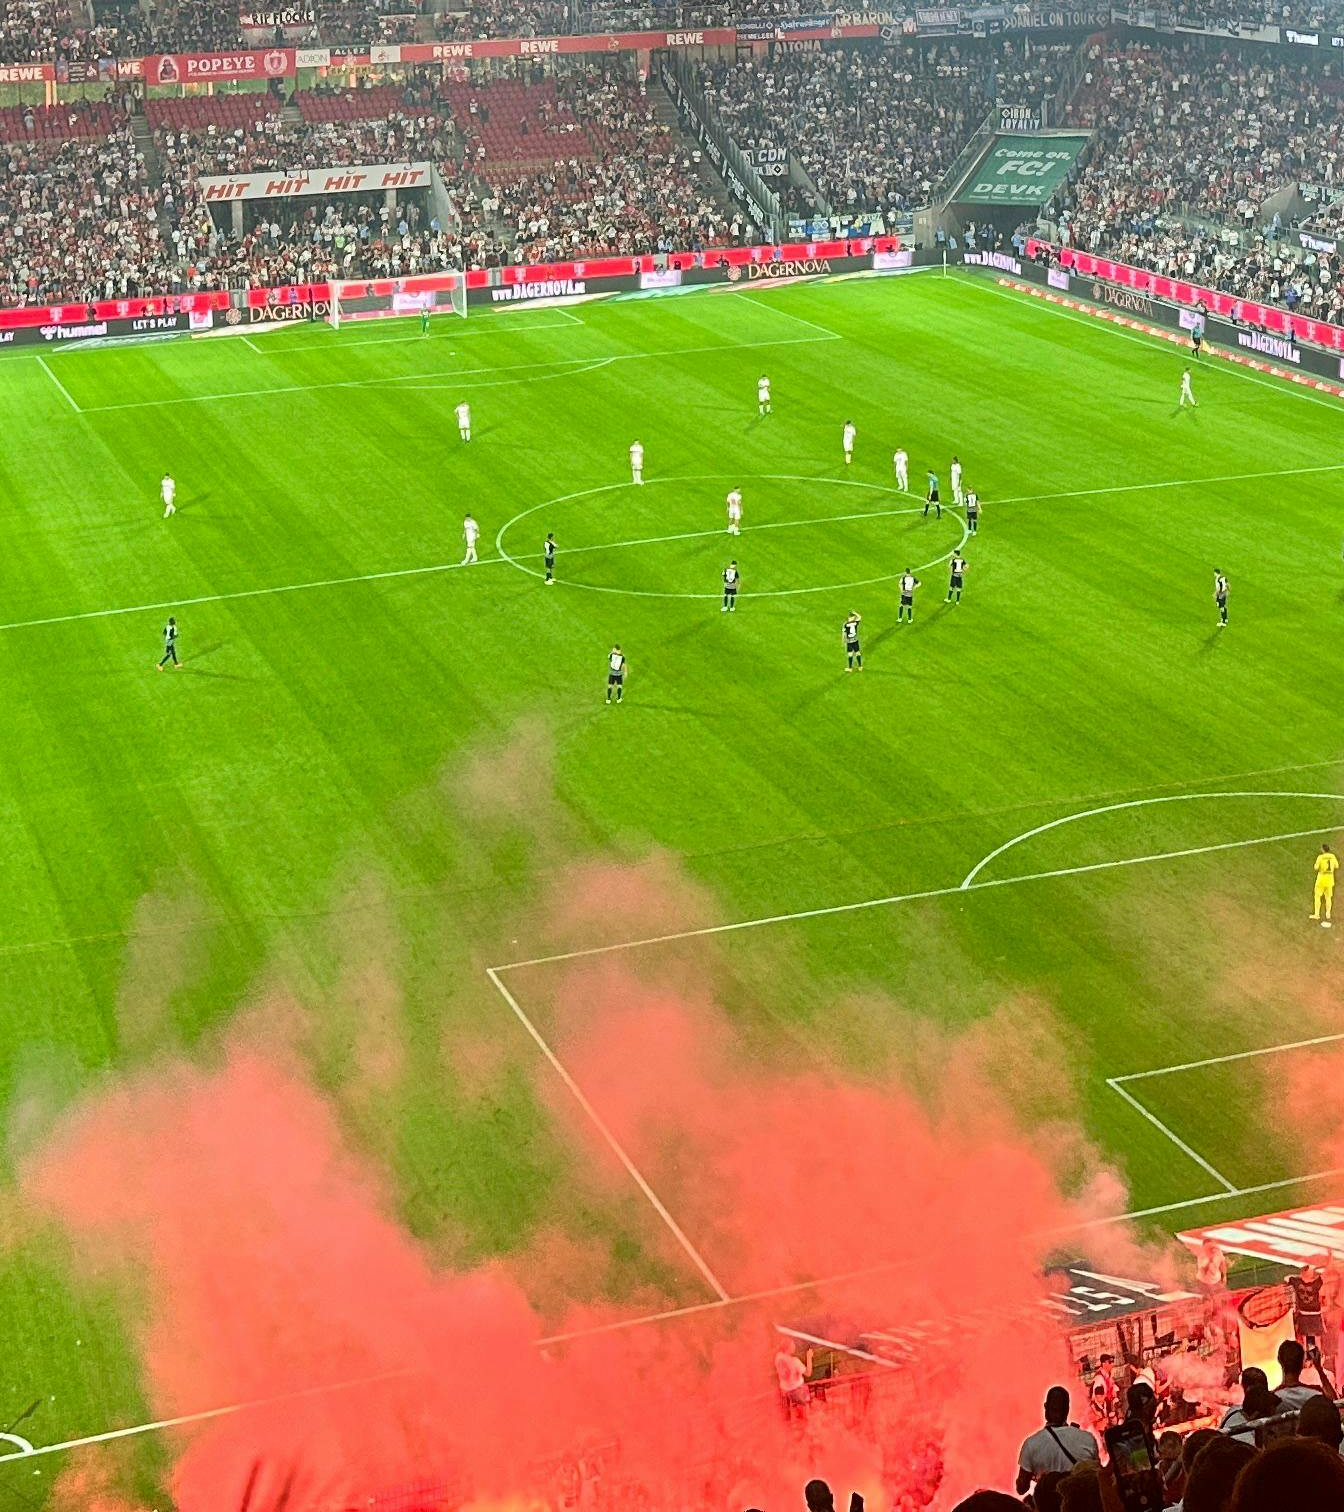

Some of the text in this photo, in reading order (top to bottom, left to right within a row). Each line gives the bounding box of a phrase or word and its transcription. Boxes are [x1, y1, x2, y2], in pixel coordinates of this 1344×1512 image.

[1011, 12, 1048, 28] DANIEL
[1049, 11, 1063, 25] ON
[666, 33, 704, 45] REWE
[432, 45, 473, 58] REWE
[520, 41, 559, 54] REWE
[187, 56, 255, 73] POPEYE
[0, 68, 44, 82] REWE
[995, 149, 1042, 158] Come
[996, 160, 1056, 176] FC!
[324, 174, 367, 190] HIT
[381, 170, 424, 187] HIT
[205, 183, 251, 199] HIT
[265, 179, 309, 195] HIT
[972, 183, 1046, 195] DEVK
[748, 260, 831, 280] DAGERNOVA
[56, 322, 107, 339] hummel
[132, 317, 177, 330] LET'S PLAY
